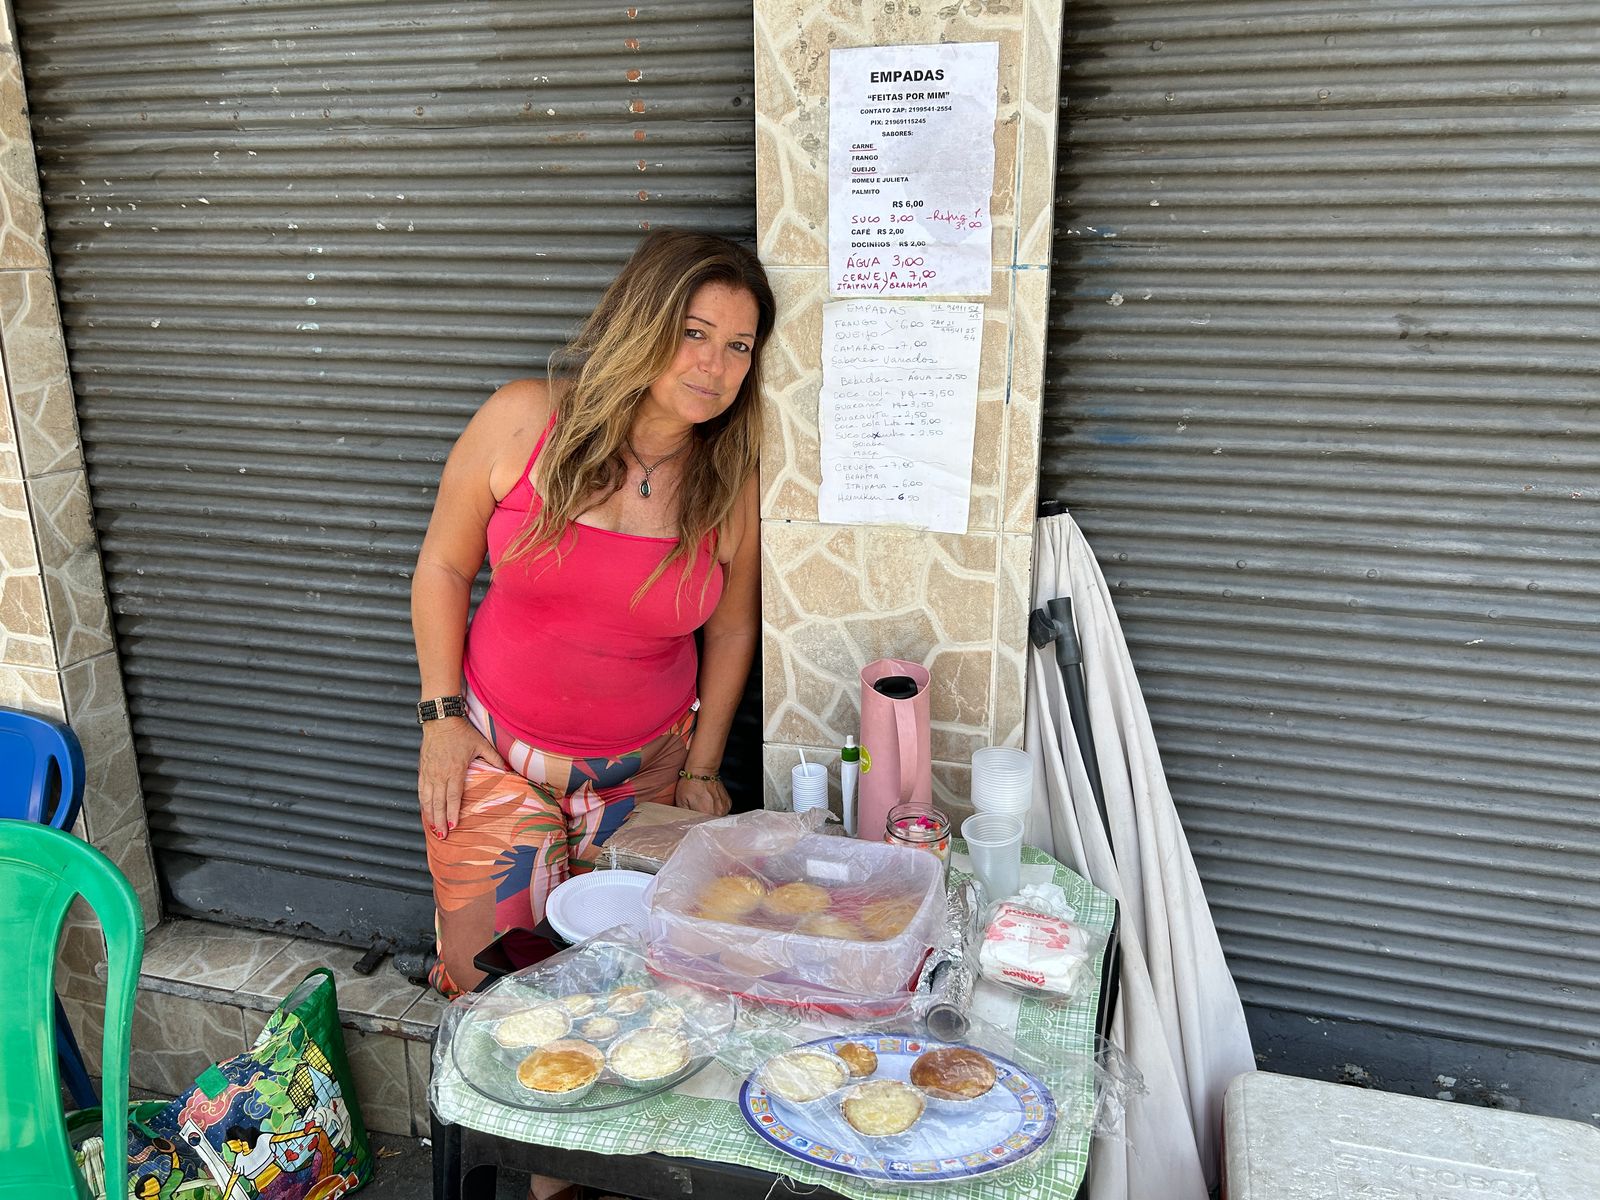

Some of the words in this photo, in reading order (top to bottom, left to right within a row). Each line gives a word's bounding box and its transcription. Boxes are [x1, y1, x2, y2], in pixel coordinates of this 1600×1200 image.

[870, 69, 944, 83] EMPADAS
[906, 92, 924, 100] POR
[908, 105, 952, 113] 2199541-2554
[892, 200, 903, 208] R$
[905, 200, 924, 209] 6,00
[852, 216, 881, 224] SUCO
[890, 215, 914, 224] 3,00
[955, 221, 982, 230] 3,00
[846, 252, 880, 269] ÁGUA
[892, 254, 924, 268] 3,00
[843, 271, 898, 282] CERVEJA
[909, 270, 936, 281] 7,00
[847, 303, 906, 315] EMPADAS
[834, 319, 878, 328] FRANGO
